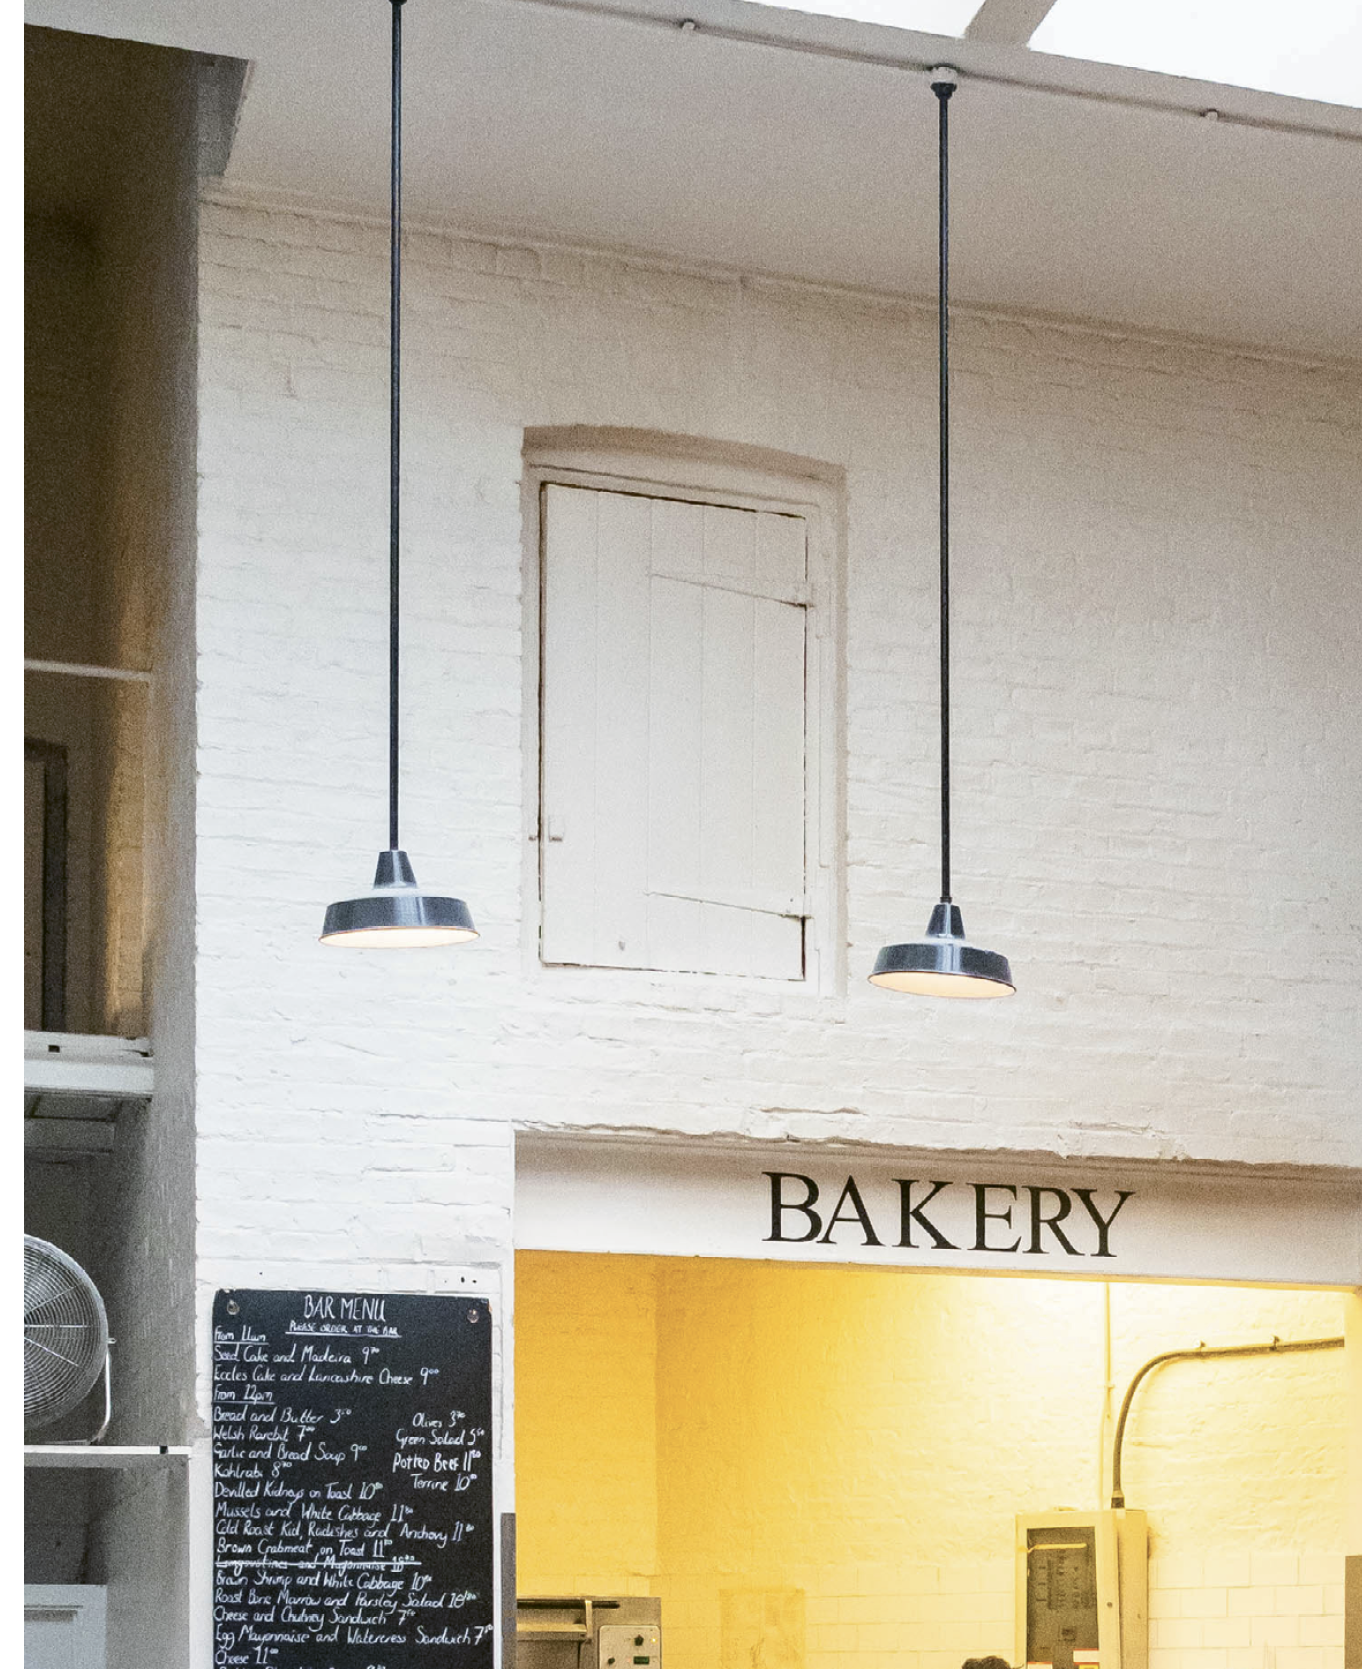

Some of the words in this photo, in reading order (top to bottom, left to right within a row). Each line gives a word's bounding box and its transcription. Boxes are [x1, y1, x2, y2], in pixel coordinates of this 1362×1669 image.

[761, 1171, 1137, 1258] BAKERY
[303, 1294, 336, 1319] BAR
[340, 1295, 386, 1322] MENU
[289, 1319, 316, 1332] PLEASE
[320, 1323, 348, 1333] ORDER
[353, 1324, 363, 1333] AT
[214, 1343, 240, 1361] Seed
[243, 1345, 268, 1362] Cake
[272, 1343, 297, 1362] and
[300, 1345, 352, 1363] Madeira
[213, 1364, 248, 1381] Eccles
[252, 1364, 276, 1381] Cake
[280, 1364, 307, 1381] and
[308, 1365, 374, 1384] Lancashire
[379, 1367, 414, 1385] Cheese
[213, 1404, 248, 1422] Bread
[250, 1406, 278, 1422] and
[280, 1406, 324, 1423] Butter
[412, 1412, 443, 1428] Olives
[213, 1424, 245, 1440] Welsh
[249, 1424, 289, 1442] Rarebit
[395, 1428, 426, 1450] Green
[429, 1428, 466, 1446] Salad
[213, 1441, 246, 1459] Garlic
[248, 1441, 273, 1459] and
[277, 1441, 313, 1461] Bread
[314, 1441, 346, 1466] Soup
[214, 1481, 260, 1499] Devilled
[263, 1480, 305, 1504] Kidneys
[308, 1488, 321, 1498] on
[324, 1481, 353, 1499] Toast
[410, 1473, 449, 1492] Terrine
[215, 1501, 261, 1519] Mussels
[265, 1502, 293, 1518] and
[301, 1502, 333, 1520] White
[338, 1504, 382, 1528] Cabbage
[216, 1519, 240, 1535] Cold
[242, 1519, 275, 1536] Roast
[308, 1520, 359, 1539] Radishes
[363, 1521, 391, 1538] and
[399, 1522, 448, 1549] Anchovy
[216, 1536, 252, 1554] Brown
[257, 1537, 313, 1554] Crabmeat
[319, 1546, 333, 1555] on
[338, 1539, 366, 1557] Toast
[253, 1570, 292, 1590] Shrimp
[296, 1571, 321, 1586] and
[322, 1571, 354, 1588] White
[356, 1571, 405, 1598] Cabbage
[215, 1587, 243, 1603] Roast
[248, 1587, 272, 1605] Bone
[277, 1588, 321, 1606] Marrow
[323, 1591, 350, 1607] and
[355, 1591, 398, 1615] Parsley
[401, 1592, 447, 1609] Salad
[213, 1605, 249, 1622] Cheese
[253, 1605, 276, 1623] and
[280, 1605, 325, 1633] Chutney
[329, 1606, 387, 1625] Sandwich
[215, 1623, 236, 1651] Egg
[238, 1624, 310, 1646] Mayonnaise
[315, 1624, 340, 1642] and
[347, 1625, 407, 1644] Watercress
[415, 1624, 471, 1645] Sandwich
